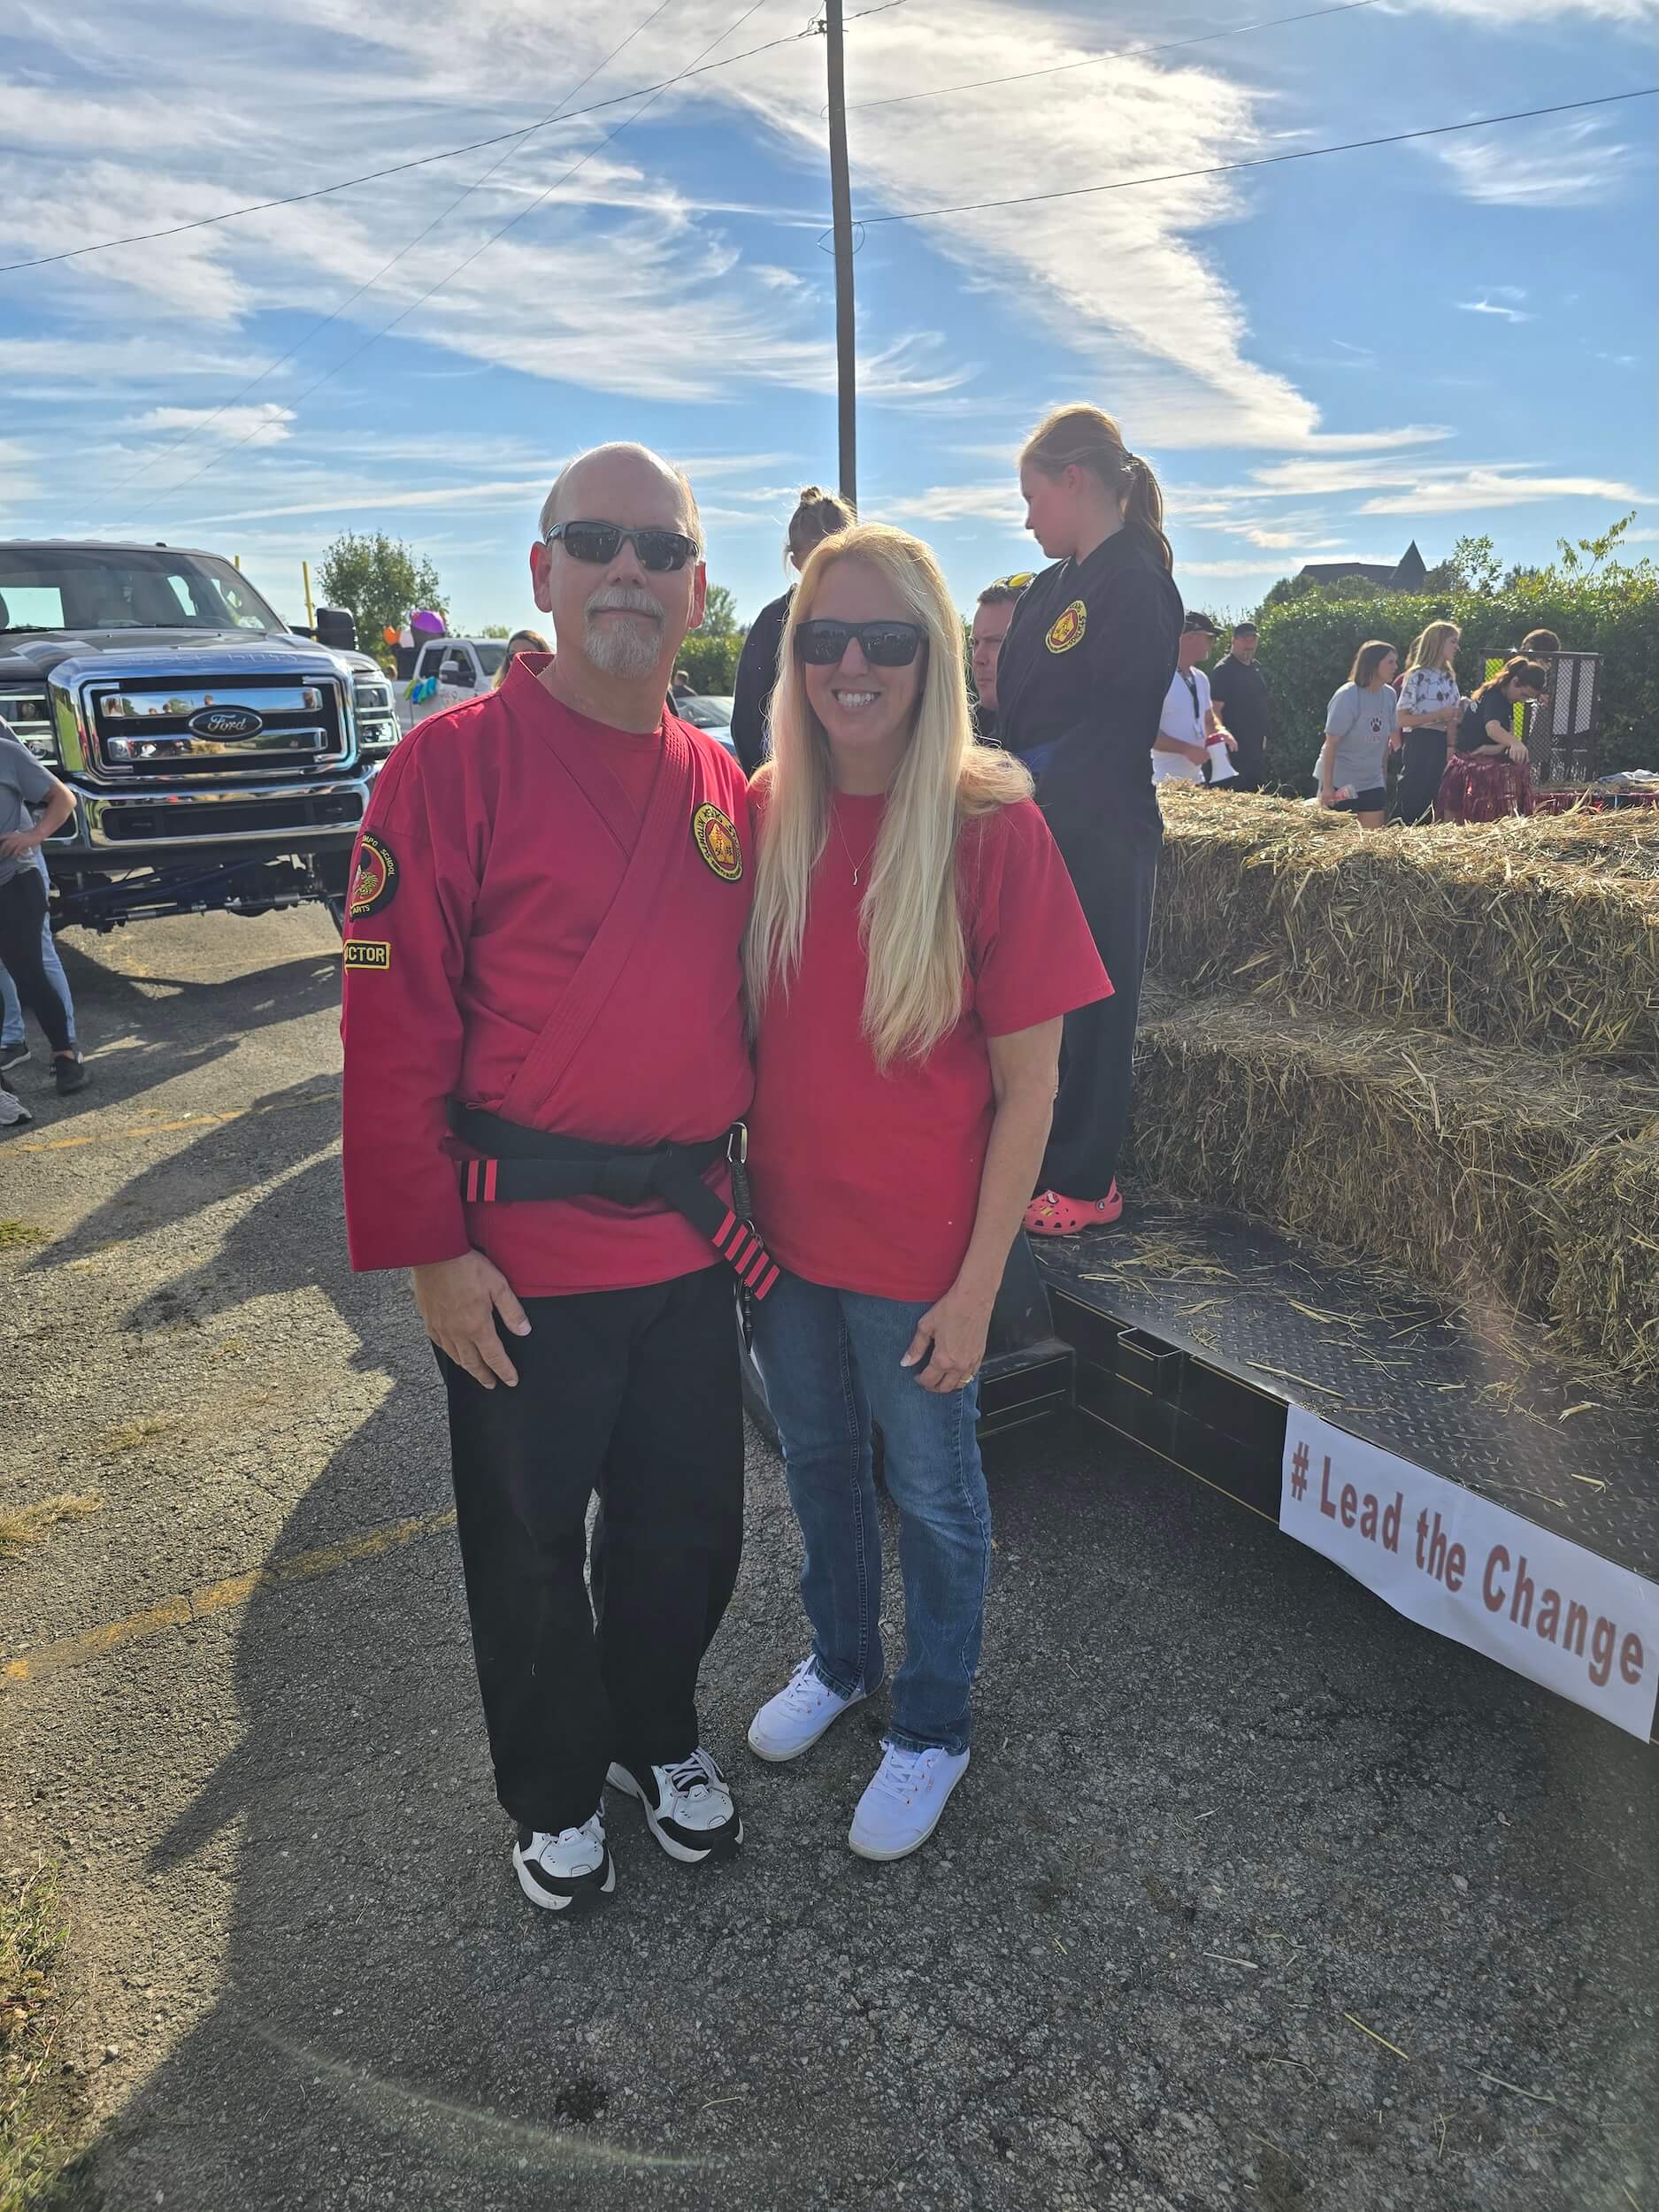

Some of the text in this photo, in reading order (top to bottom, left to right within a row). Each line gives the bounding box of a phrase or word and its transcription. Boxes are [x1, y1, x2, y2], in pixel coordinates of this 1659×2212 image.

[207, 714, 247, 731] Ford
[380, 849, 395, 876] SCHOOL
[346, 946, 385, 963] CTOR
[1291, 1440, 1645, 1687] # Lead the Change
